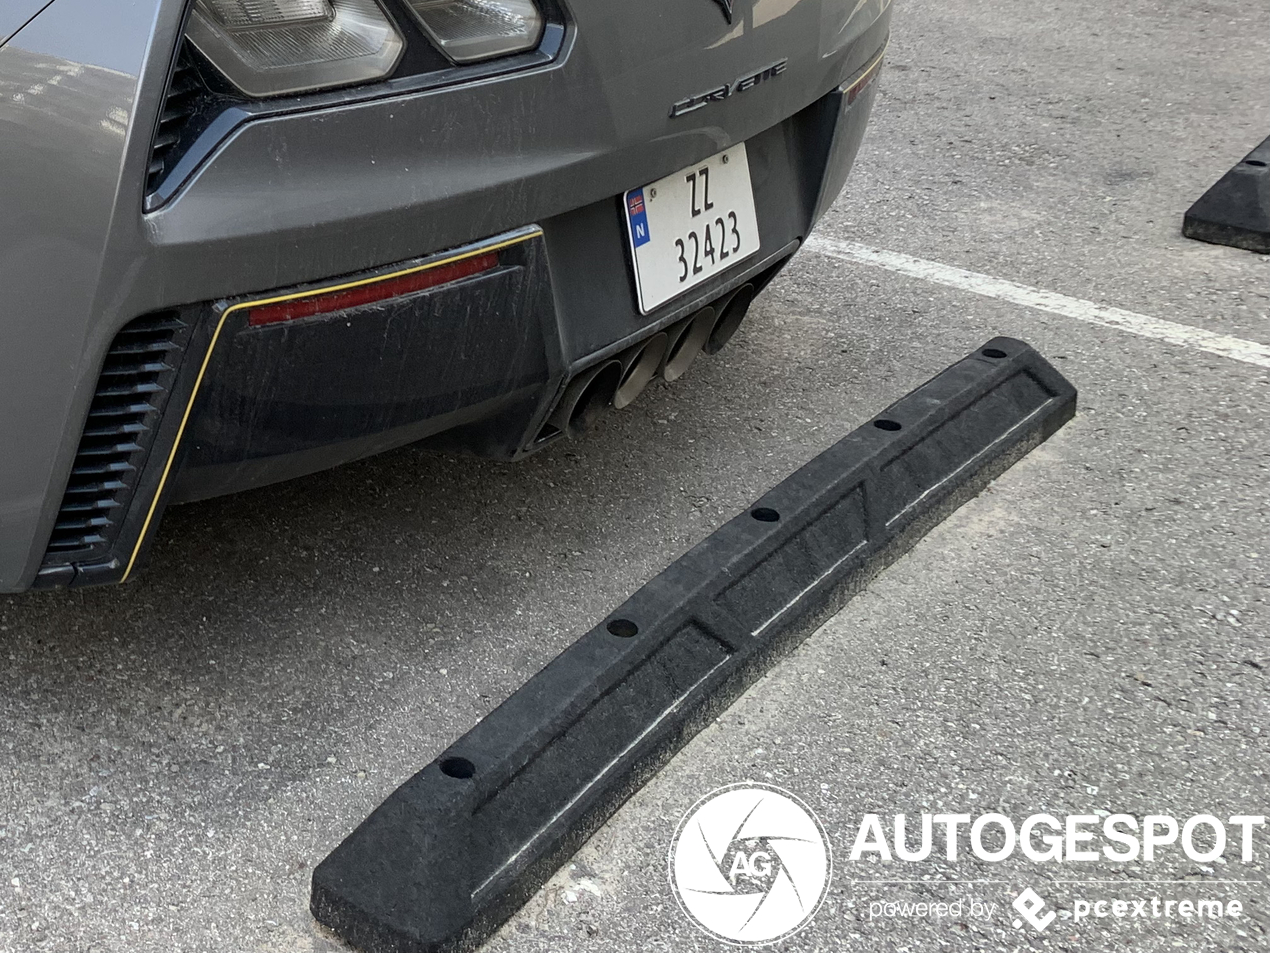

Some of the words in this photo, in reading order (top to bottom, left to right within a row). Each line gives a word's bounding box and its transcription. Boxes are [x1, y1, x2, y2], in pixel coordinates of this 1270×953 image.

[684, 166, 714, 218] ZZ
[635, 222, 646, 239] N
[674, 210, 741, 283] 32423
